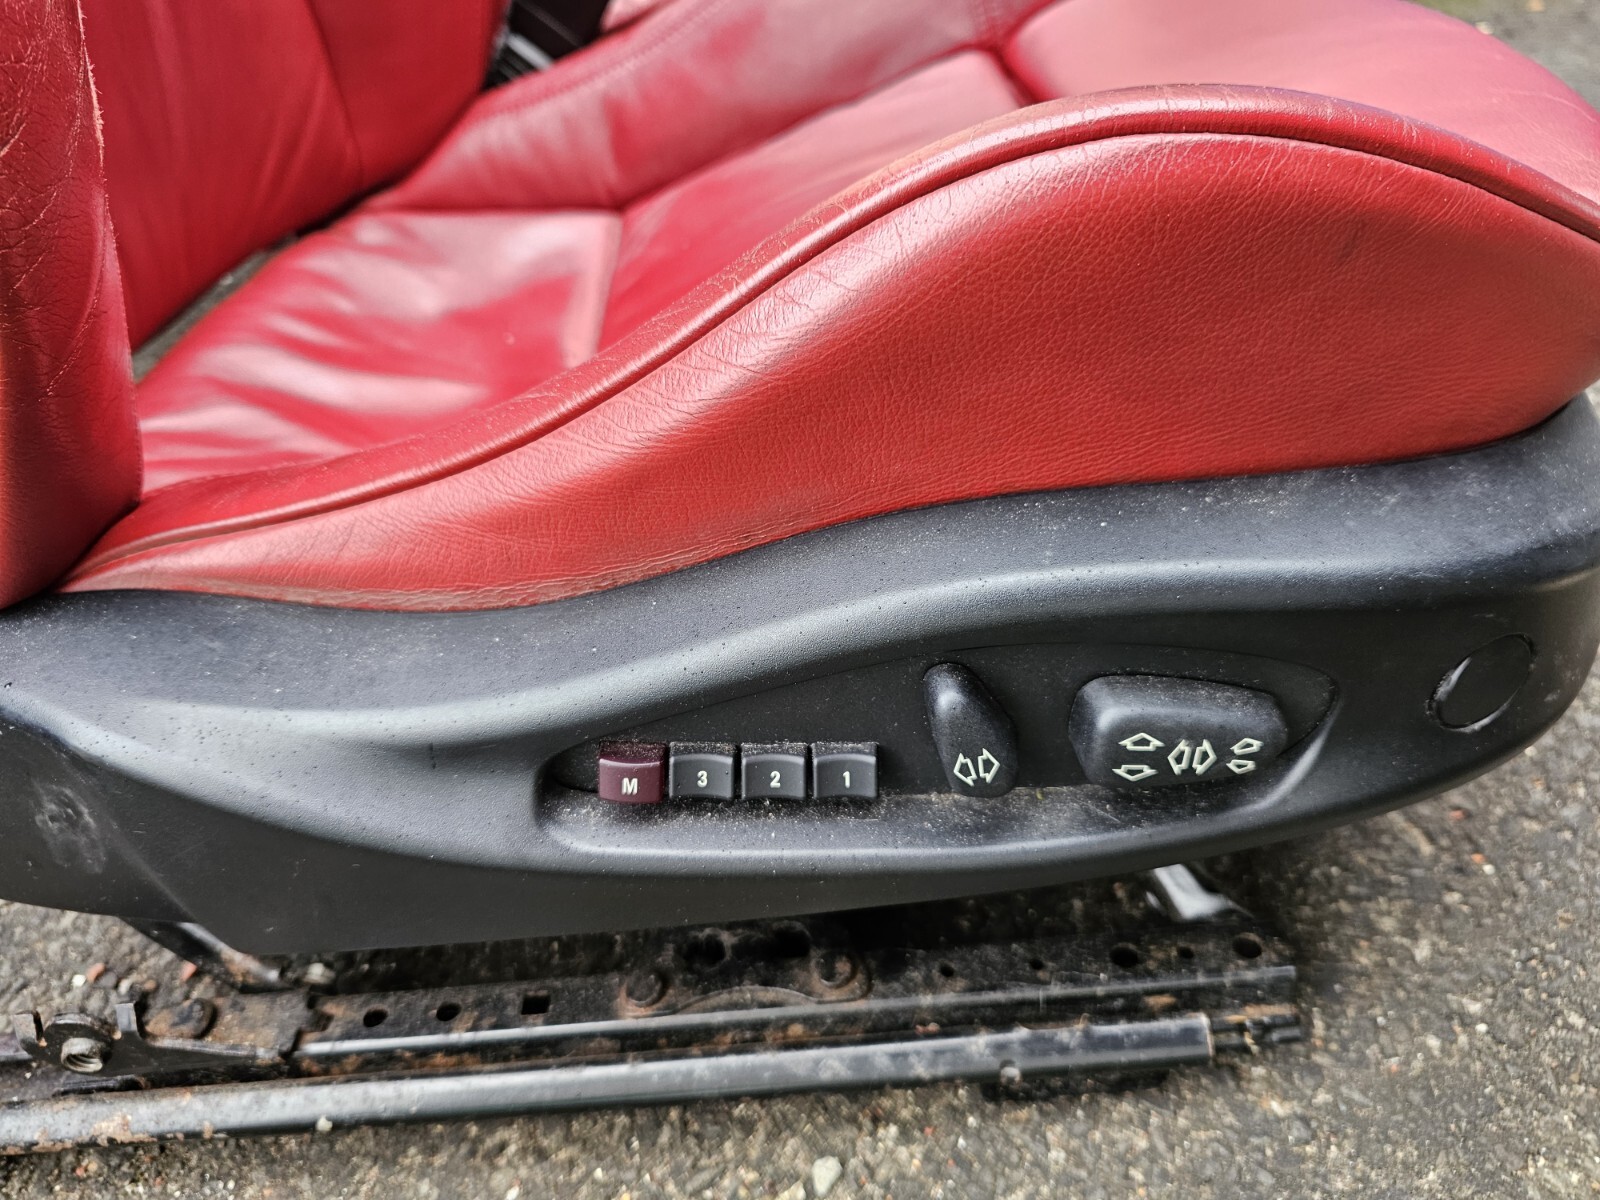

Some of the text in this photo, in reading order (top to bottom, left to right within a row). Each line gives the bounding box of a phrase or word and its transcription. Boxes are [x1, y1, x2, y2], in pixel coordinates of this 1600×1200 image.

[621, 777, 638, 795] M
[696, 770, 708, 788] 3
[769, 770, 781, 789] 2
[842, 770, 851, 789] 1
